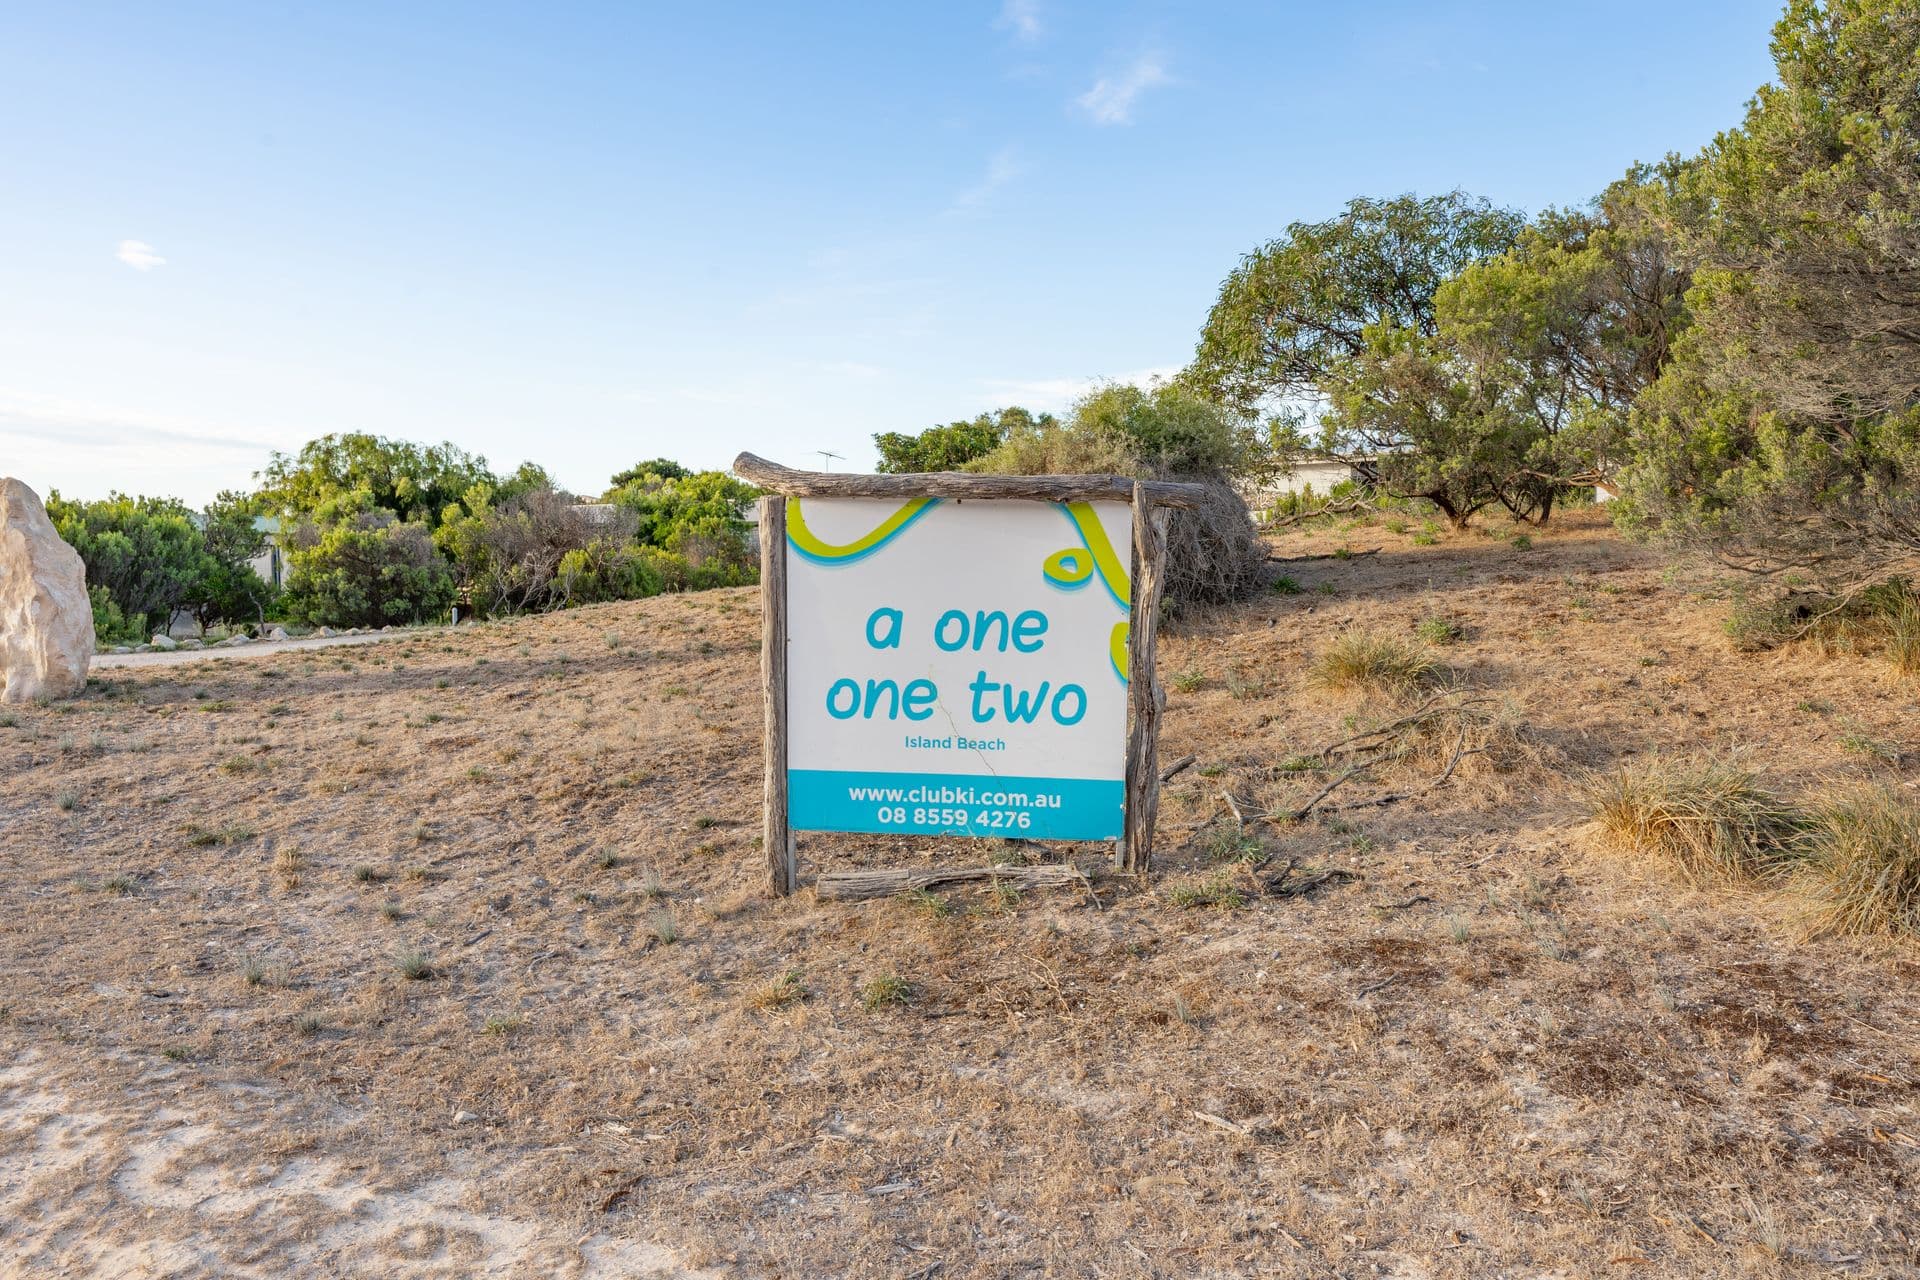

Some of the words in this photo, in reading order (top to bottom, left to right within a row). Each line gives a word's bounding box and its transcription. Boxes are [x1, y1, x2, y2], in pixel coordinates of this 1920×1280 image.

[865, 606, 905, 651] a
[933, 609, 1050, 654] one
[825, 677, 939, 721] one
[968, 670, 1088, 727] two
[904, 735, 952, 749] Island
[956, 736, 1006, 751] Beach
[848, 786, 1062, 808] www.clubki.com.au
[877, 806, 906, 824] 08
[913, 807, 968, 826] 8559
[975, 810, 1031, 829] 4276
